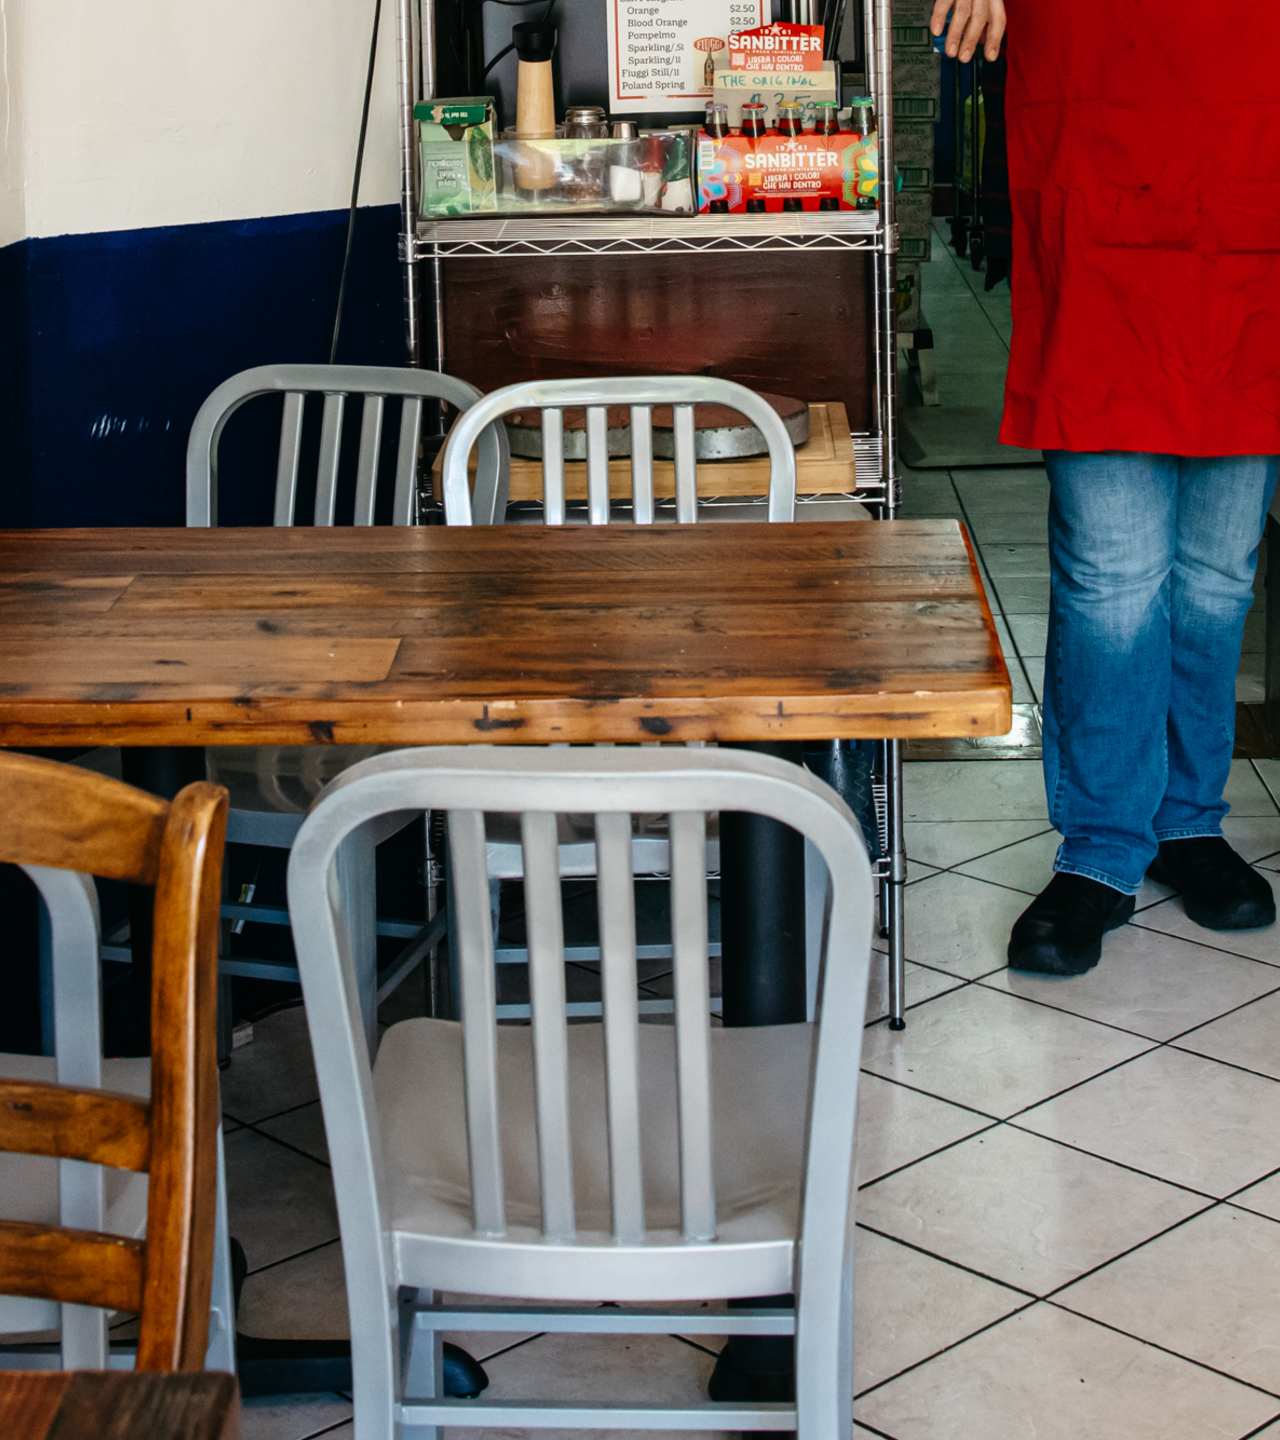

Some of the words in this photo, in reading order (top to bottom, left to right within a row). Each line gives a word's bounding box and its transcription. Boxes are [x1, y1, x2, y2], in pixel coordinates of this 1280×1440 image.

[627, 6, 660, 17] Orange
[729, 4, 755, 14] $2.50
[627, 18, 655, 28] Blood
[655, 18, 688, 29] Orange
[729, 16, 756, 26] $2.50
[627, 30, 677, 42] Pompelmo
[729, 33, 823, 52] SANBITTÈR
[622, 80, 654, 91] Poland
[655, 80, 686, 91] Spring
[720, 74, 746, 88] THE
[751, 74, 818, 88] ORIGINAL
[744, 148, 840, 169] SANBITTÈR
